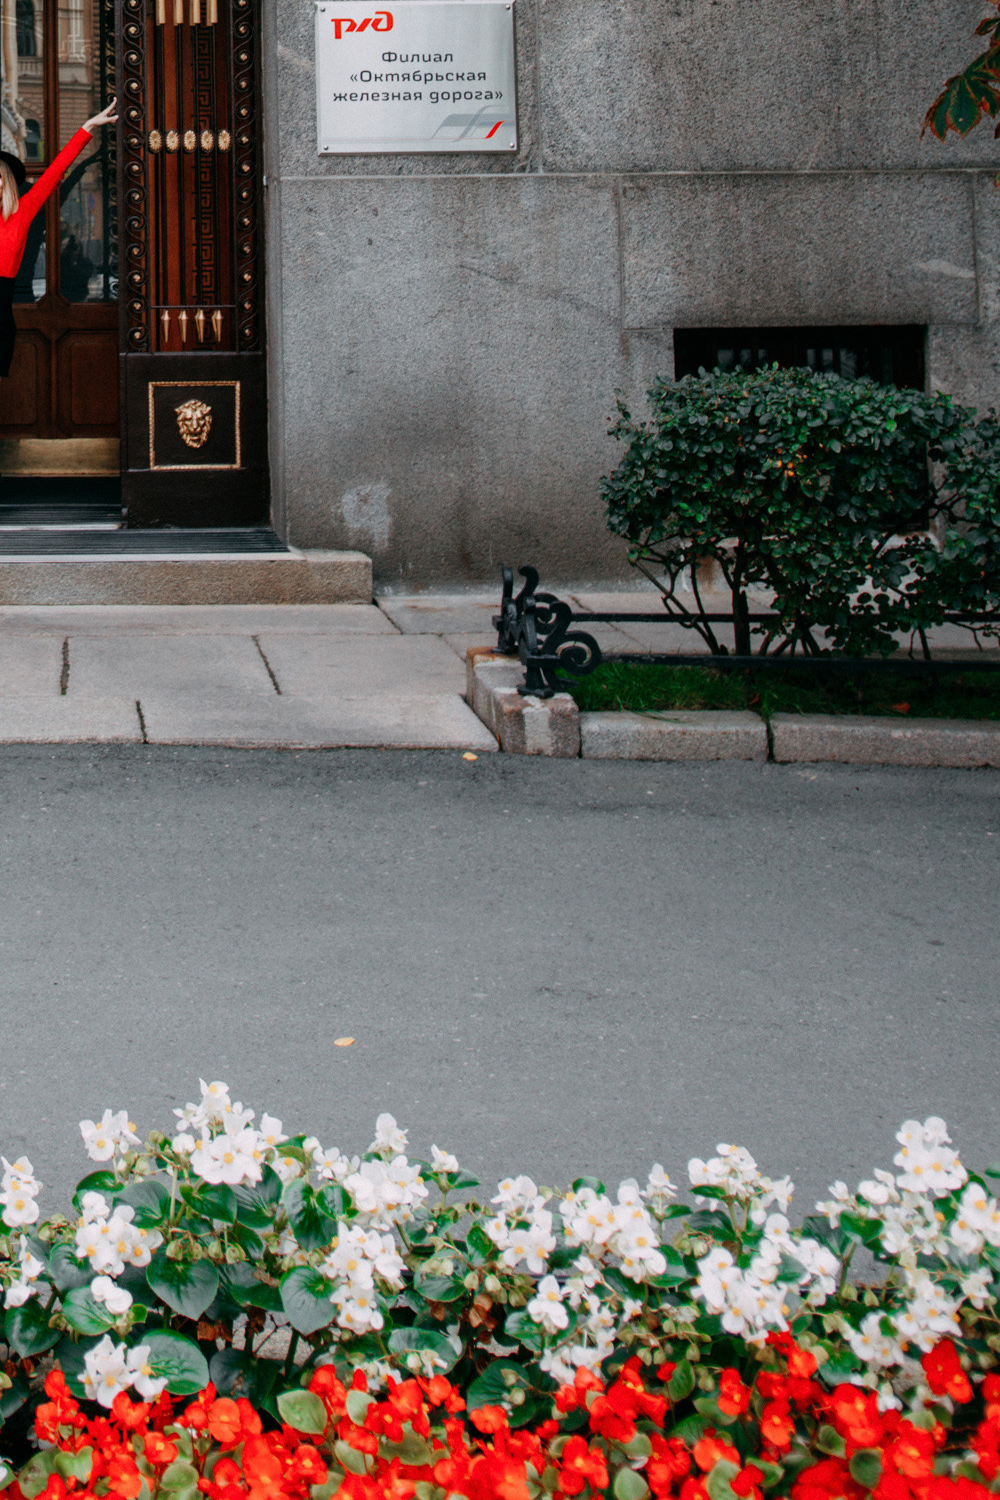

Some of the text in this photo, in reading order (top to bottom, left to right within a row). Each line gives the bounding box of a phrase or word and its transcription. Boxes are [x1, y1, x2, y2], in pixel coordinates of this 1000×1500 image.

[381, 51, 453, 63] Филиал
[350, 70, 487, 84] «Октябрьская
[333, 90, 503, 103] железная дорога»
